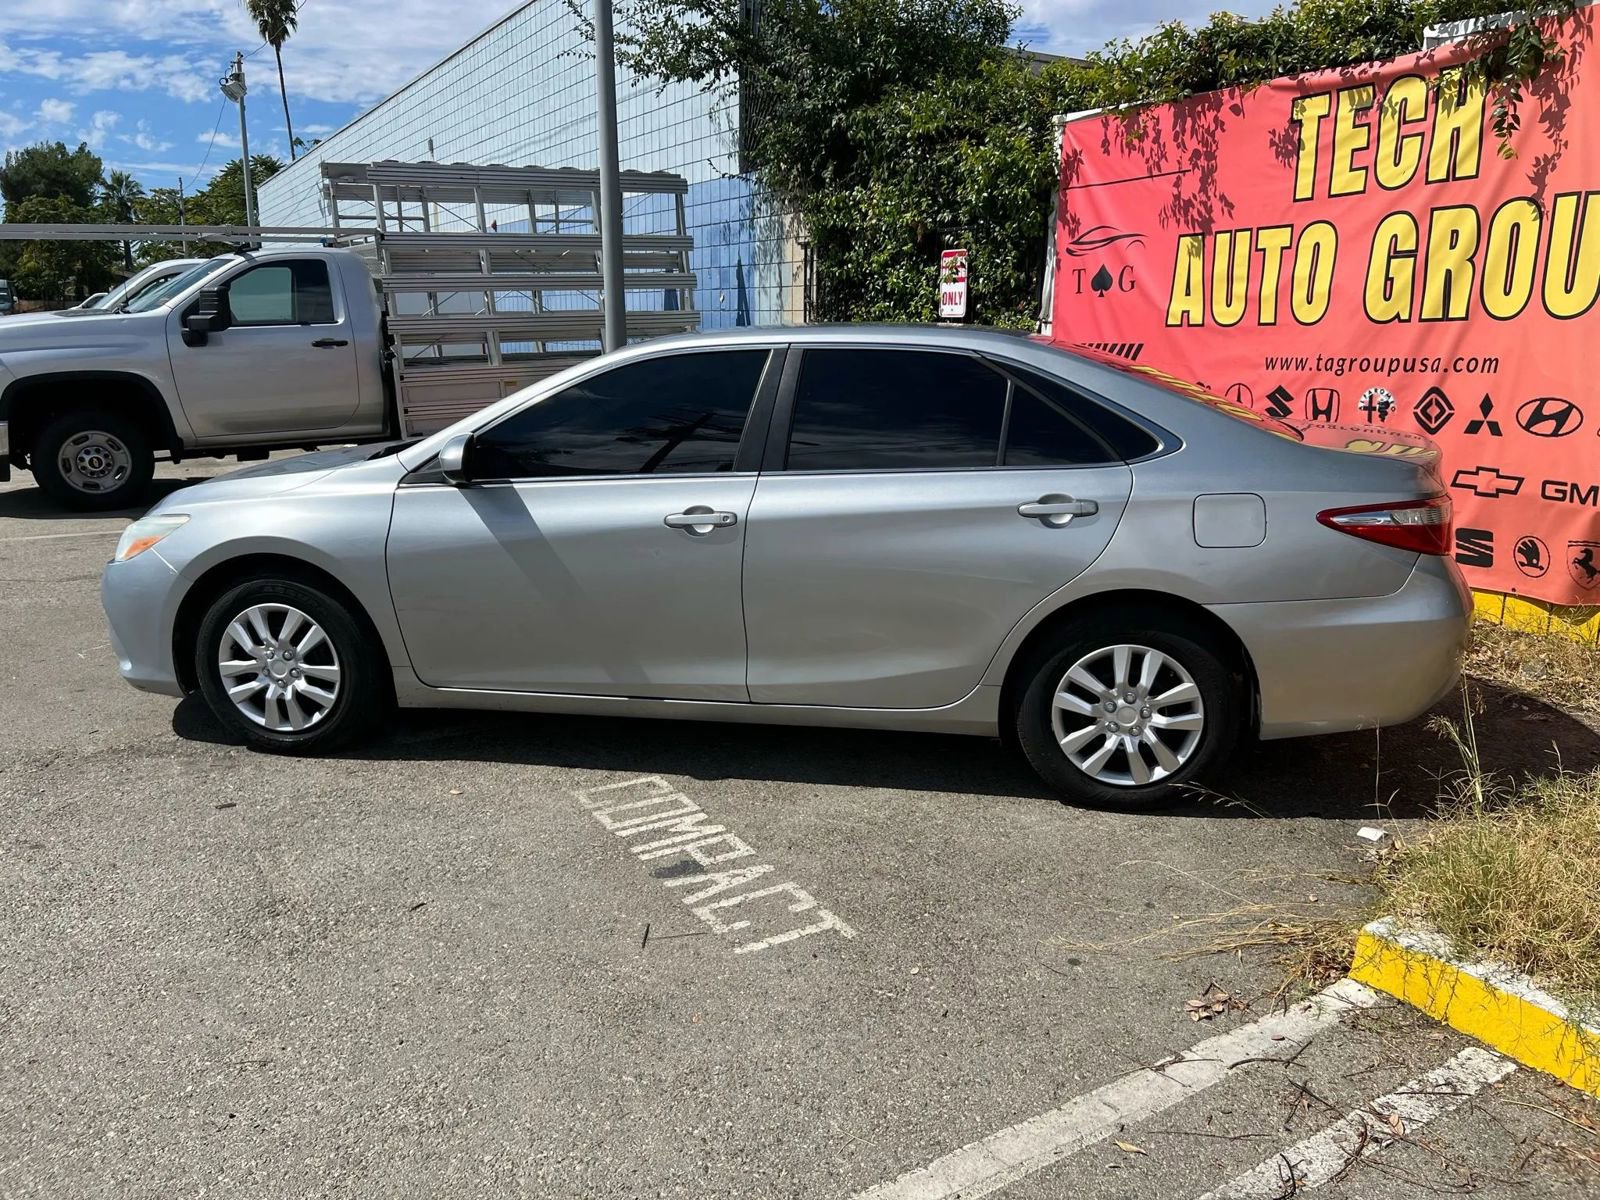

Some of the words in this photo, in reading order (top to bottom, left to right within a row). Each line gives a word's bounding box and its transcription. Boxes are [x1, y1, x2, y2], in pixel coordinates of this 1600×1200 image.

[1293, 66, 1488, 202] TECH
[942, 291, 963, 306] ONLY
[1165, 221, 1338, 327] AUTO
[1265, 353, 1499, 377] www.tagroupusa.com
[575, 775, 856, 954] COMPACT
